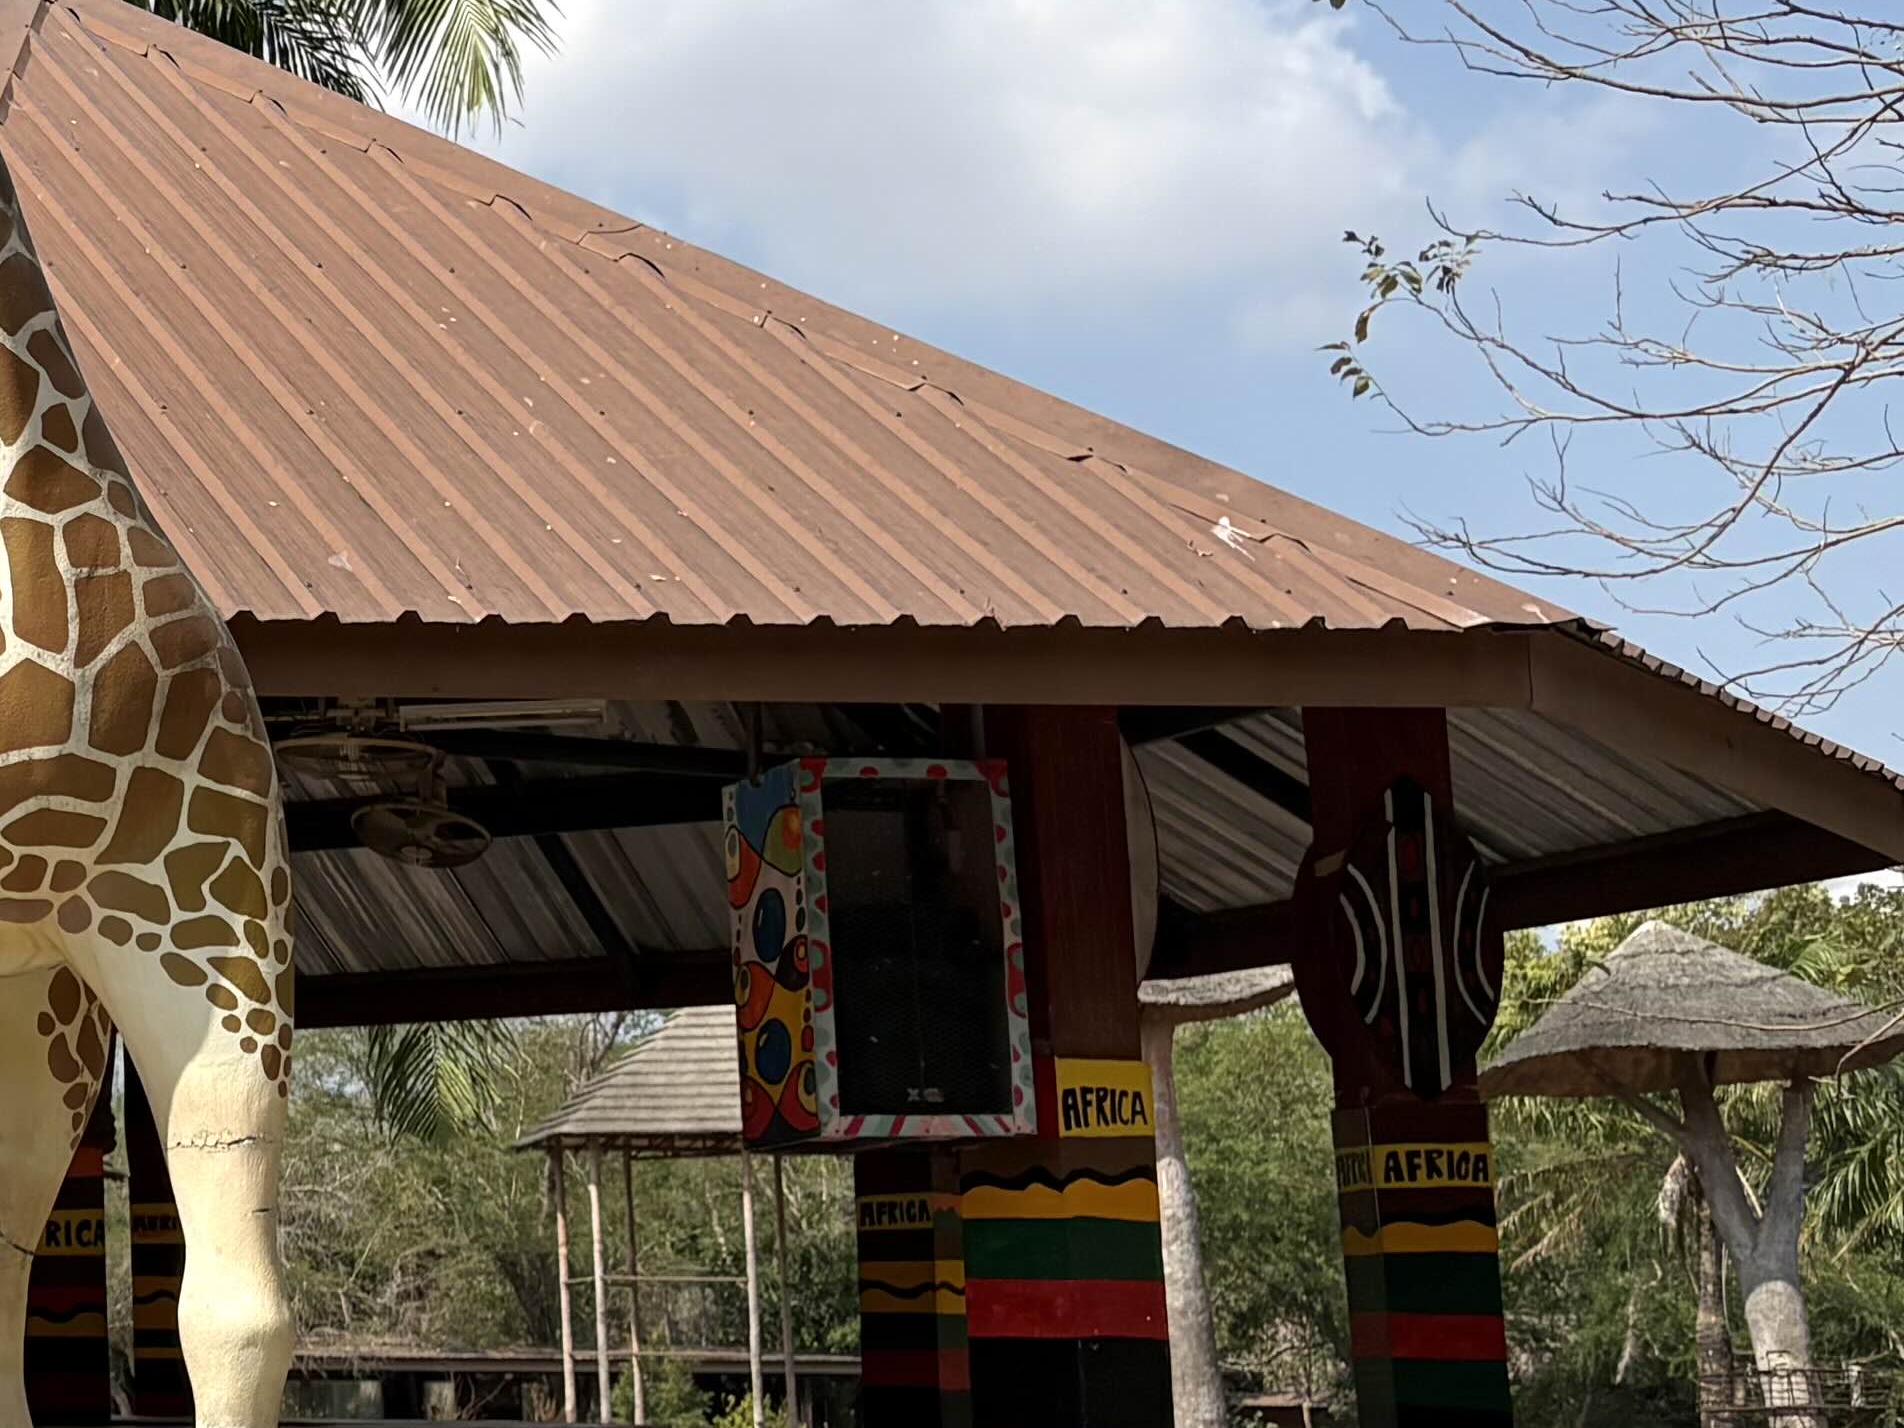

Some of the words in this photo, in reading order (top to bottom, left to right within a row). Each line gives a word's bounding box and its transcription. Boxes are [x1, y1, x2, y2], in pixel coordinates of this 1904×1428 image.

[1061, 1085, 1148, 1132] AFRICA
[1383, 1148, 1489, 1184] AFRICA
[859, 1199, 932, 1227] AFRICA
[46, 1220, 105, 1247] RICA
